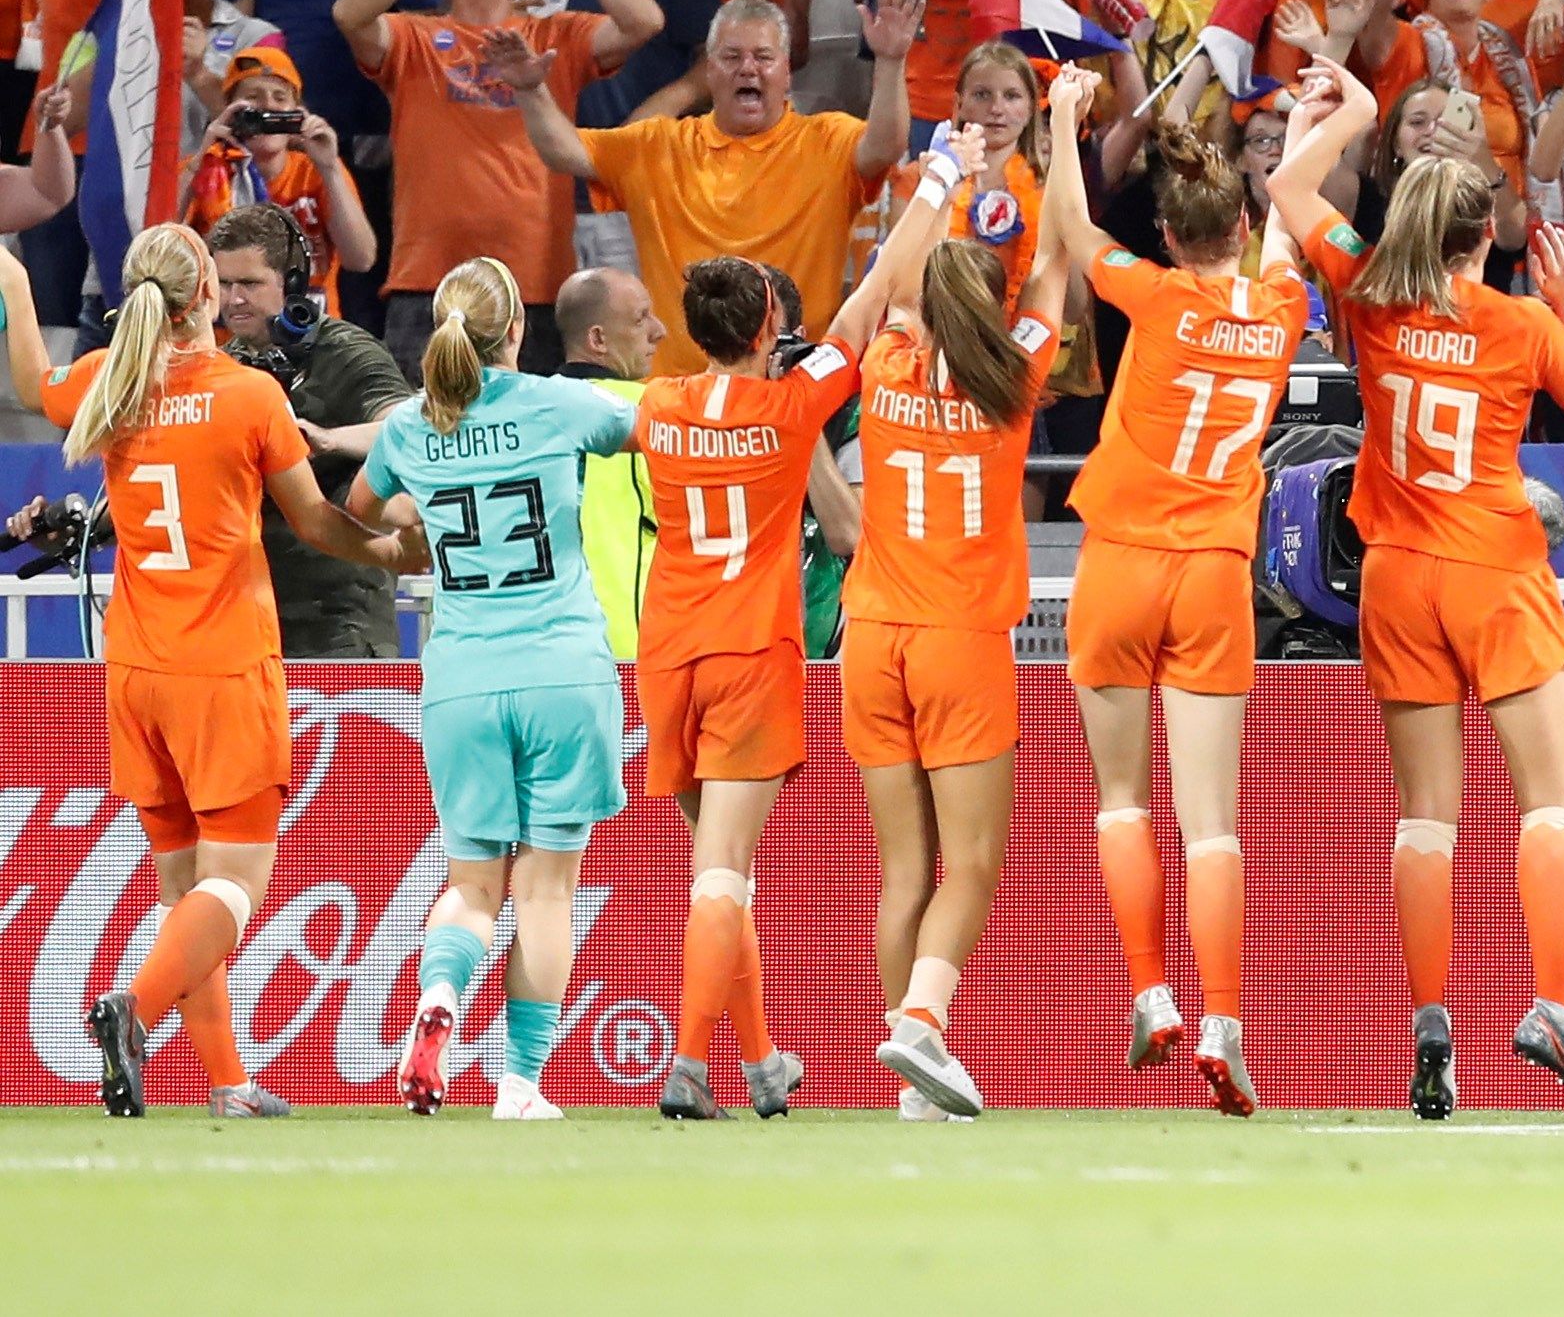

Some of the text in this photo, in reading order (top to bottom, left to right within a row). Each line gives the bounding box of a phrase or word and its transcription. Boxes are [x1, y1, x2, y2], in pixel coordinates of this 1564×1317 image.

[1176, 310, 1286, 358] E. JANSEN
[1395, 324, 1477, 367] ROORD
[158, 392, 214, 427] GRAGT
[424, 420, 521, 463] GEURTS
[648, 419, 781, 458] VAN DONGEN
[1171, 370, 1272, 480] 17
[1282, 412, 1322, 421] SONY
[1379, 372, 1479, 493] 19
[128, 463, 191, 572] 3
[884, 449, 982, 540] 11
[427, 476, 557, 592] 23
[685, 484, 749, 581] 4
